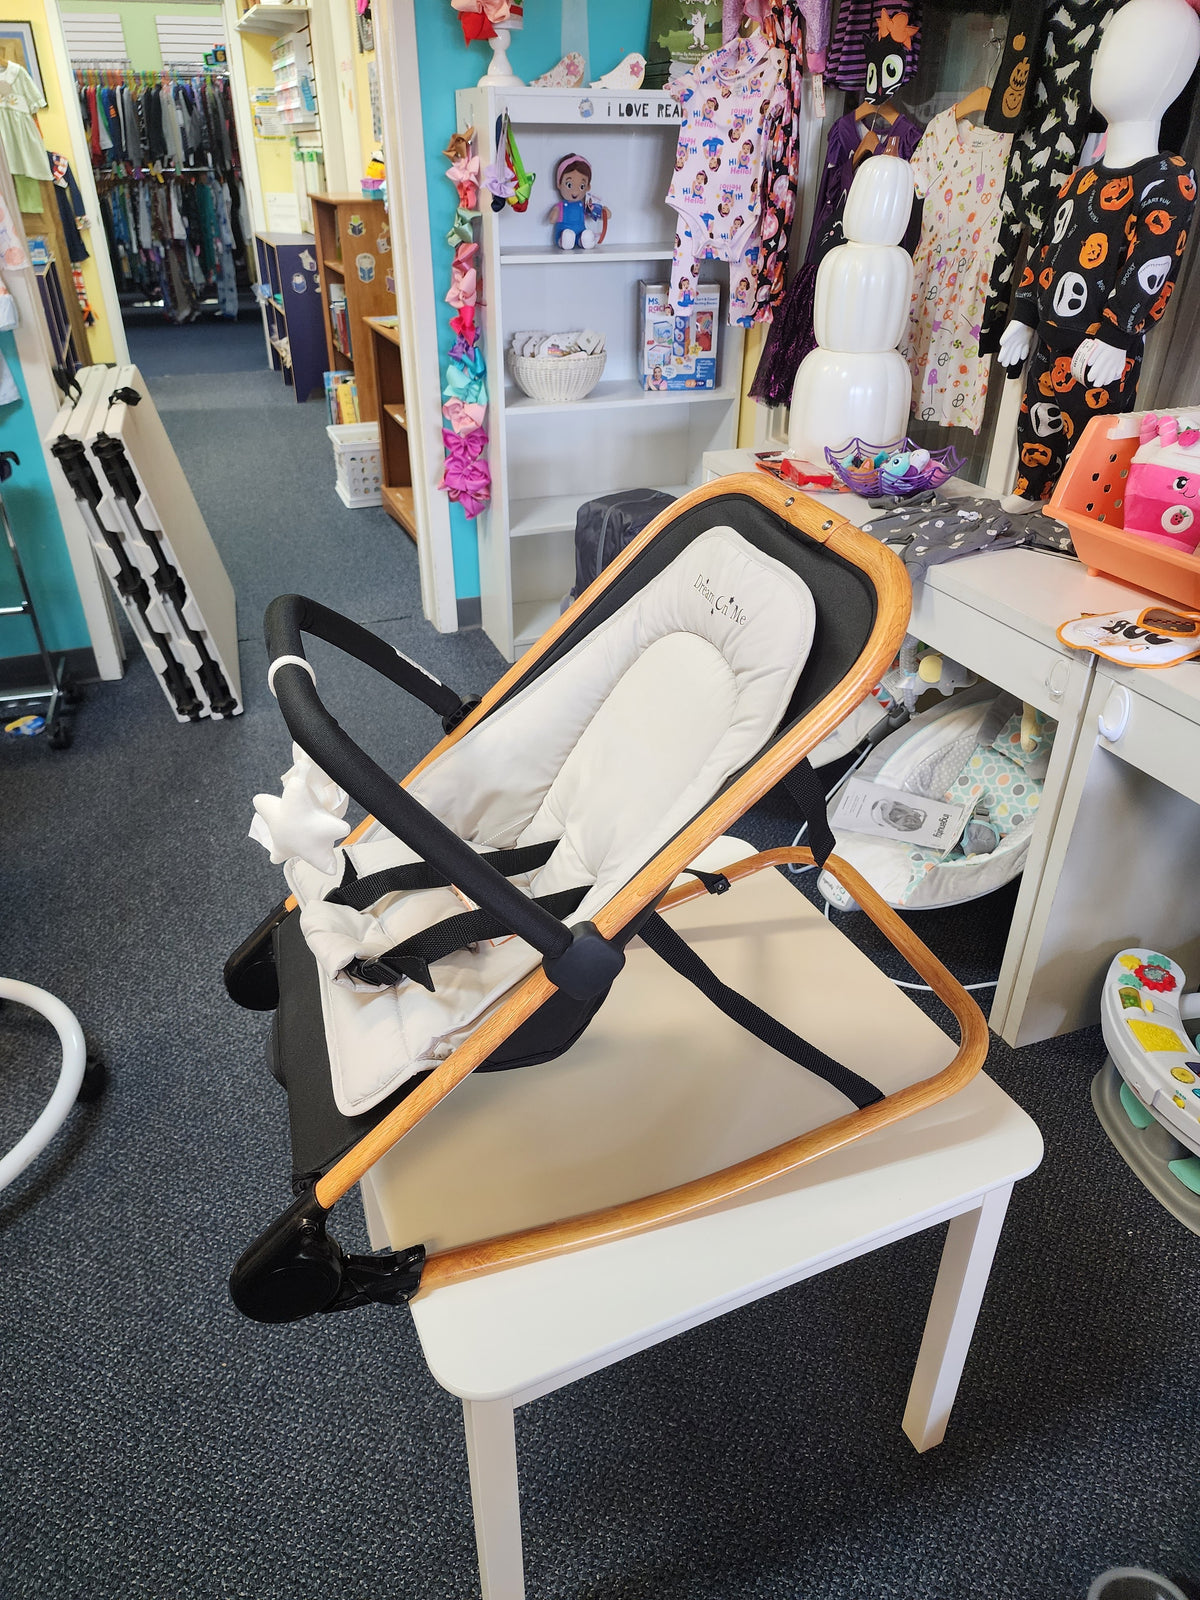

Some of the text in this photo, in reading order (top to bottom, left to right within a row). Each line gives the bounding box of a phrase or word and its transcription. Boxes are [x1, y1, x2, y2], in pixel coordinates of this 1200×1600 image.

[618, 103, 649, 117] LOVE
[657, 104, 683, 118] REA
[693, 110, 701, 118] HI
[1141, 197, 1171, 208] SCARY FUN
[1121, 263, 1136, 285] SPOOKY
[693, 573, 715, 605] Dream
[730, 604, 747, 625] Me
